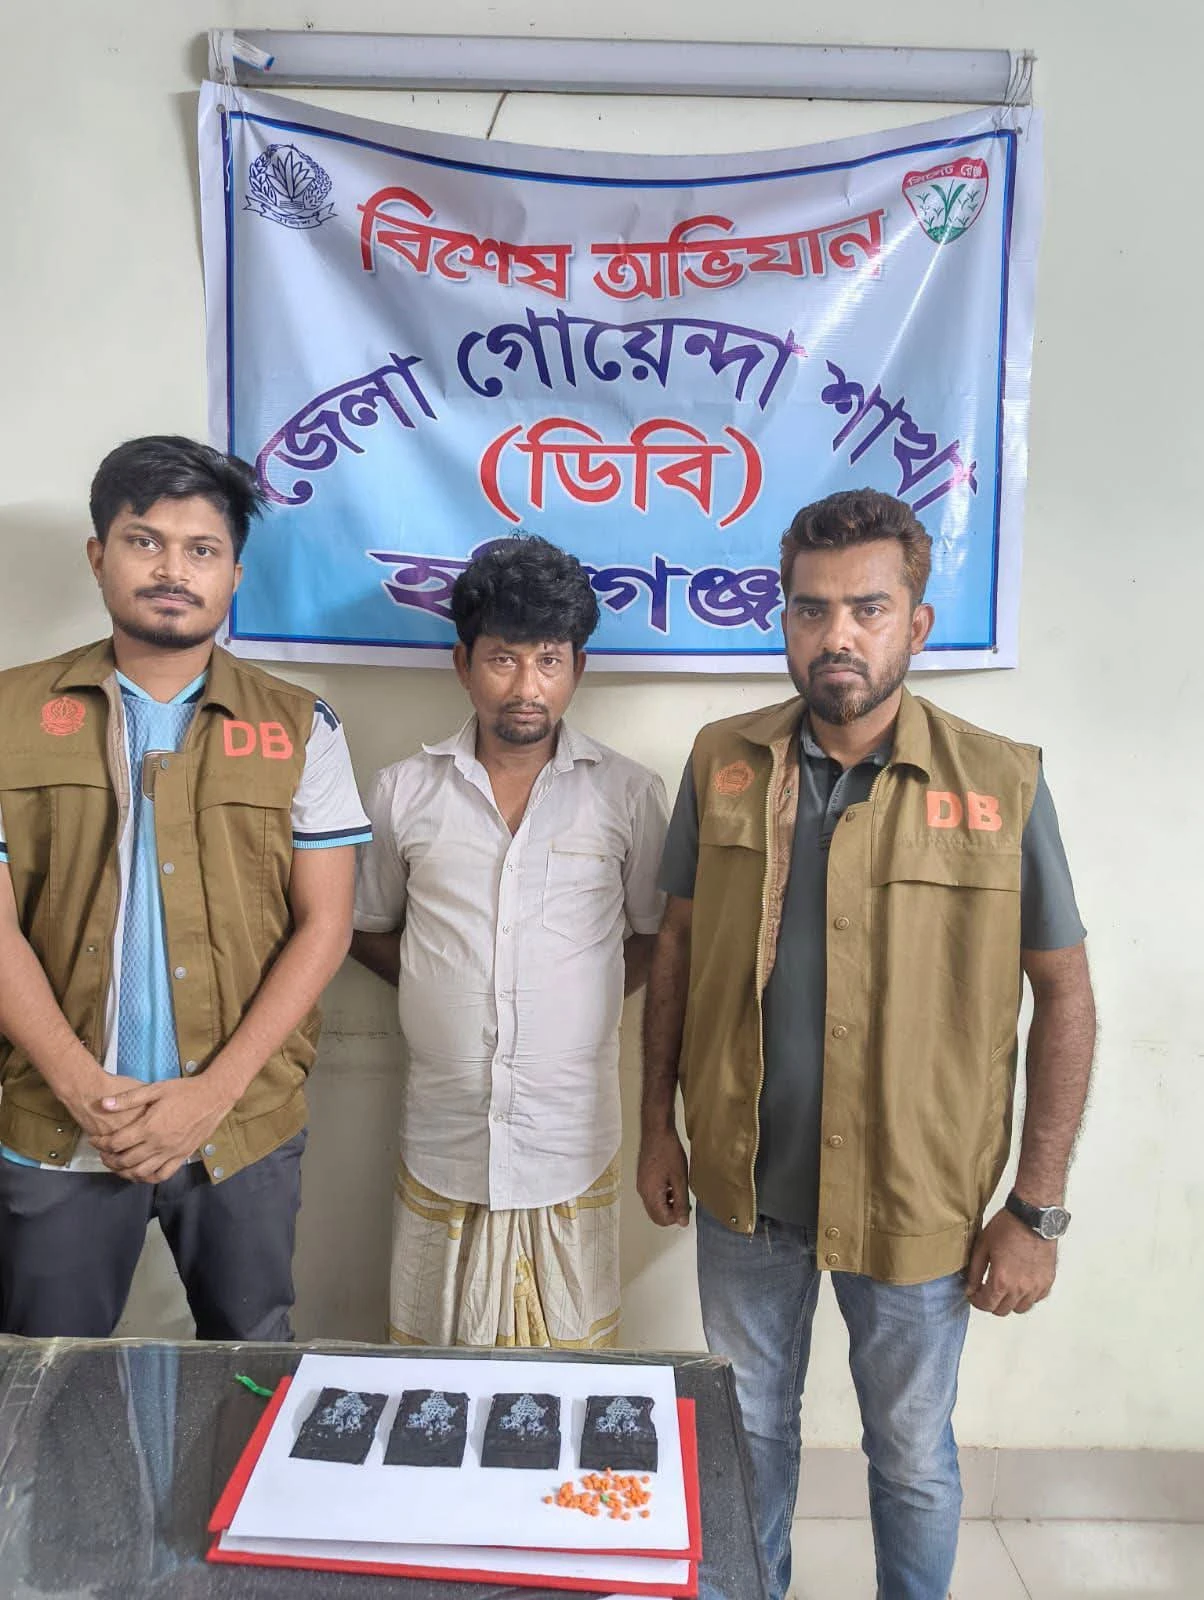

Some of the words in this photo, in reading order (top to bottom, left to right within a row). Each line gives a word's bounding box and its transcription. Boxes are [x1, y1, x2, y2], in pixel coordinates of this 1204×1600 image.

[357, 186, 573, 299] বিশেষ
[591, 215, 885, 299] অভিযান
[256, 353, 437, 505] জেলা
[457, 307, 807, 410] গোয়েন্দা
[821, 360, 977, 511] শাখা
[481, 417, 762, 528] (ডিবি)
[366, 537, 782, 633] হগঞ্জ
[223, 720, 293, 759] DB
[927, 791, 1002, 831] DB
